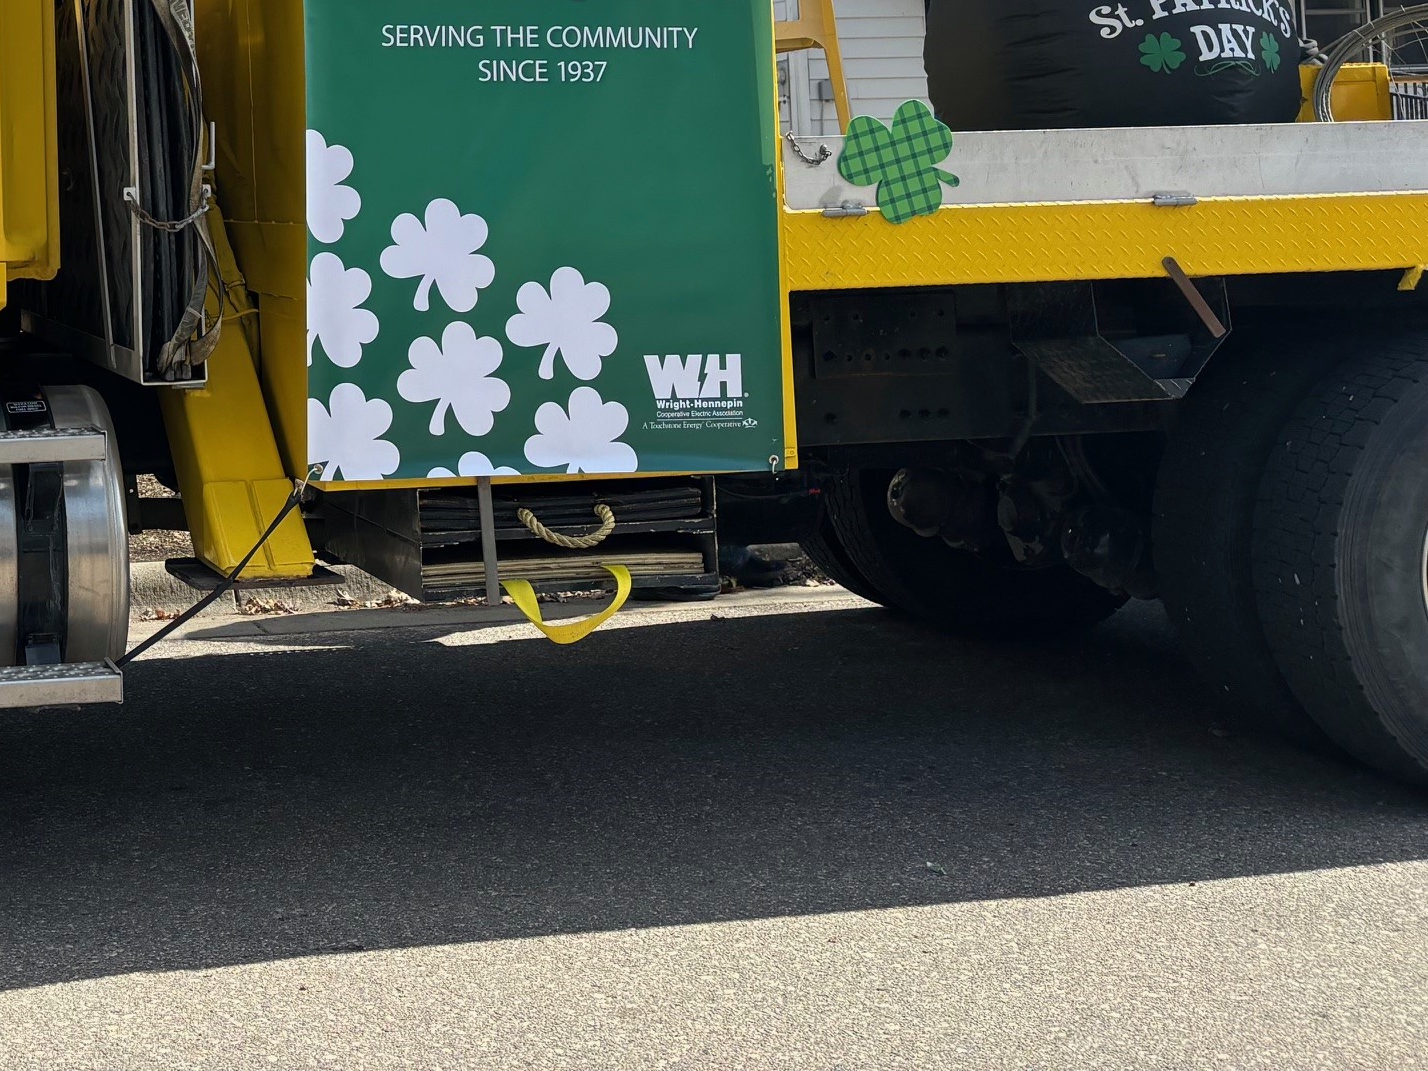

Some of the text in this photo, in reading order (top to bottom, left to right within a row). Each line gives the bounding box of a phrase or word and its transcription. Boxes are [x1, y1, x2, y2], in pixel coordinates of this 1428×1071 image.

[1089, 2, 1144, 39] St.
[382, 24, 698, 49] SERVING THE COMMUNITY
[1190, 23, 1256, 62] DAY
[478, 59, 607, 82] SINCE 1937
[643, 354, 742, 399] WH
[656, 399, 743, 410] Wright-Hennepin
[656, 410, 690, 418] Cooperative
[650, 421, 682, 429] Touchstone
[706, 420, 741, 429] Cooperative
